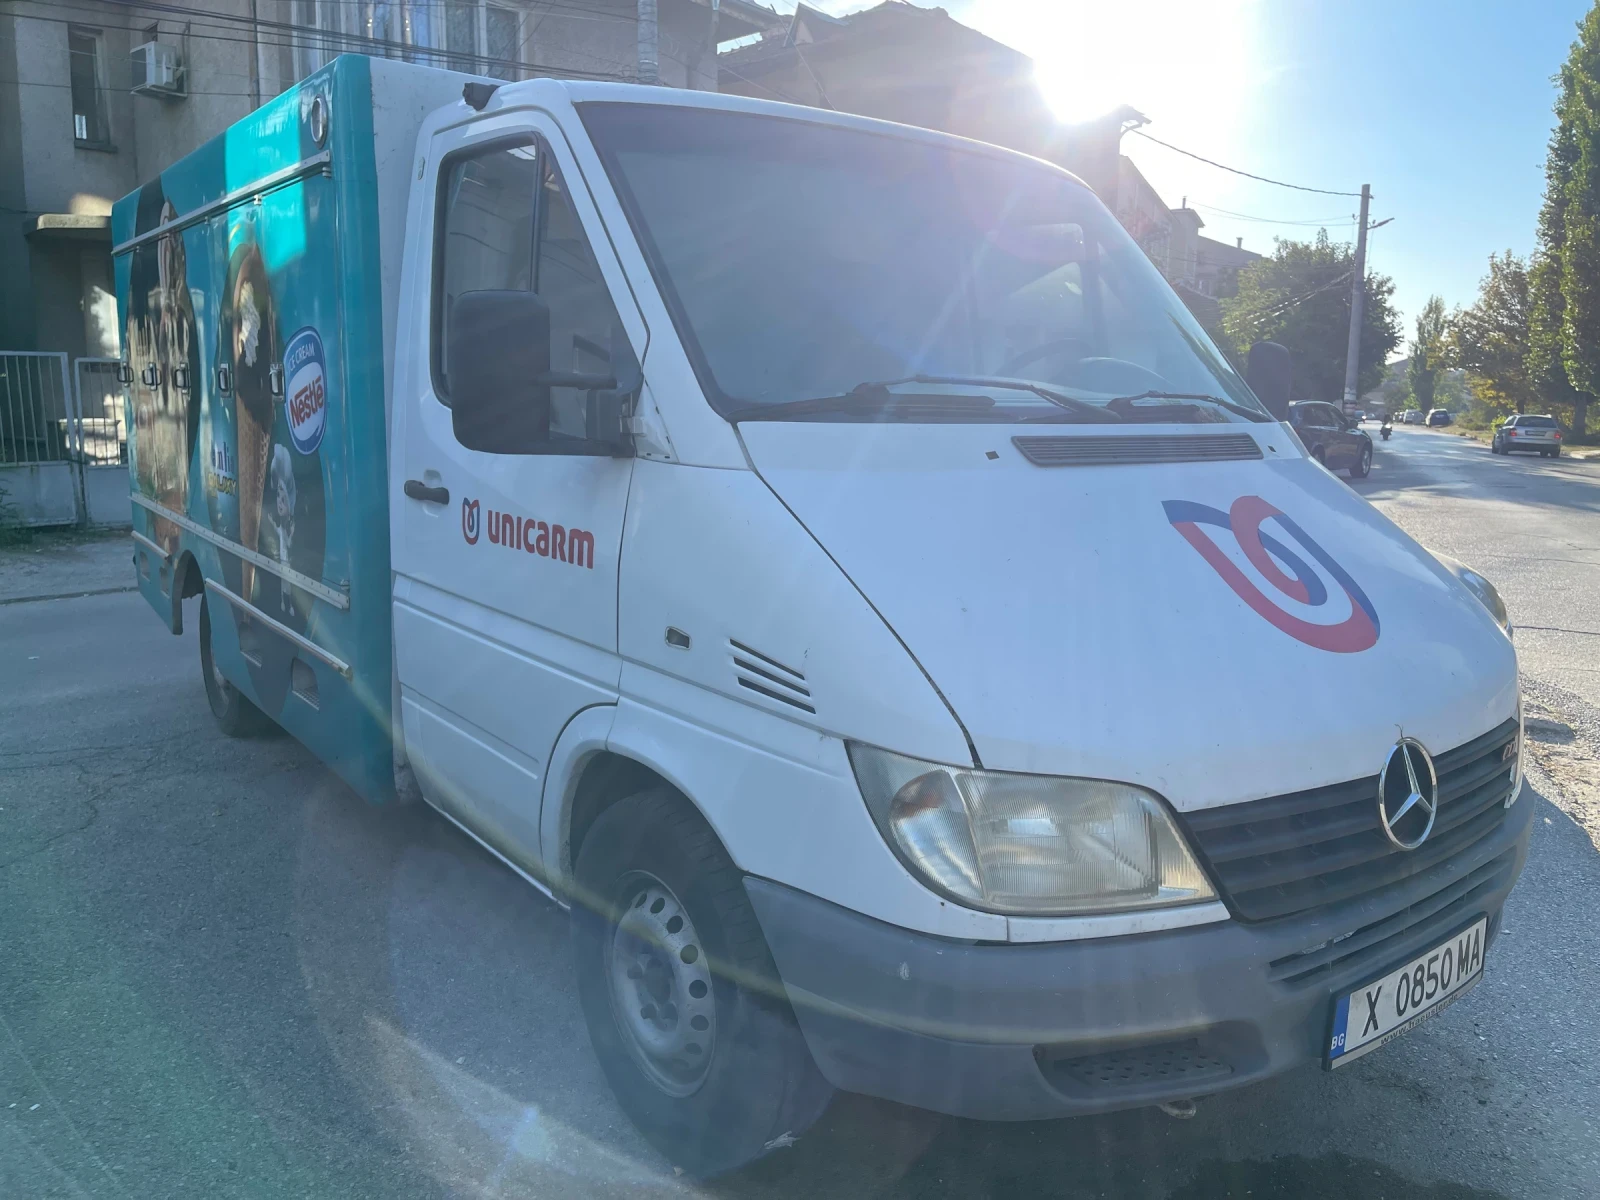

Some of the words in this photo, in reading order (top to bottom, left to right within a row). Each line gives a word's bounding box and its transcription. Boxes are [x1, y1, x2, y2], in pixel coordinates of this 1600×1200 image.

[295, 342, 315, 363] CREAM
[289, 375, 324, 429] Nestlé
[1361, 985, 1382, 1038] X
[1395, 947, 1453, 1017] 0850
[1456, 928, 1480, 983] MA
[1330, 1033, 1344, 1050] BG
[1380, 993, 1458, 1045] www.haeusler.de
